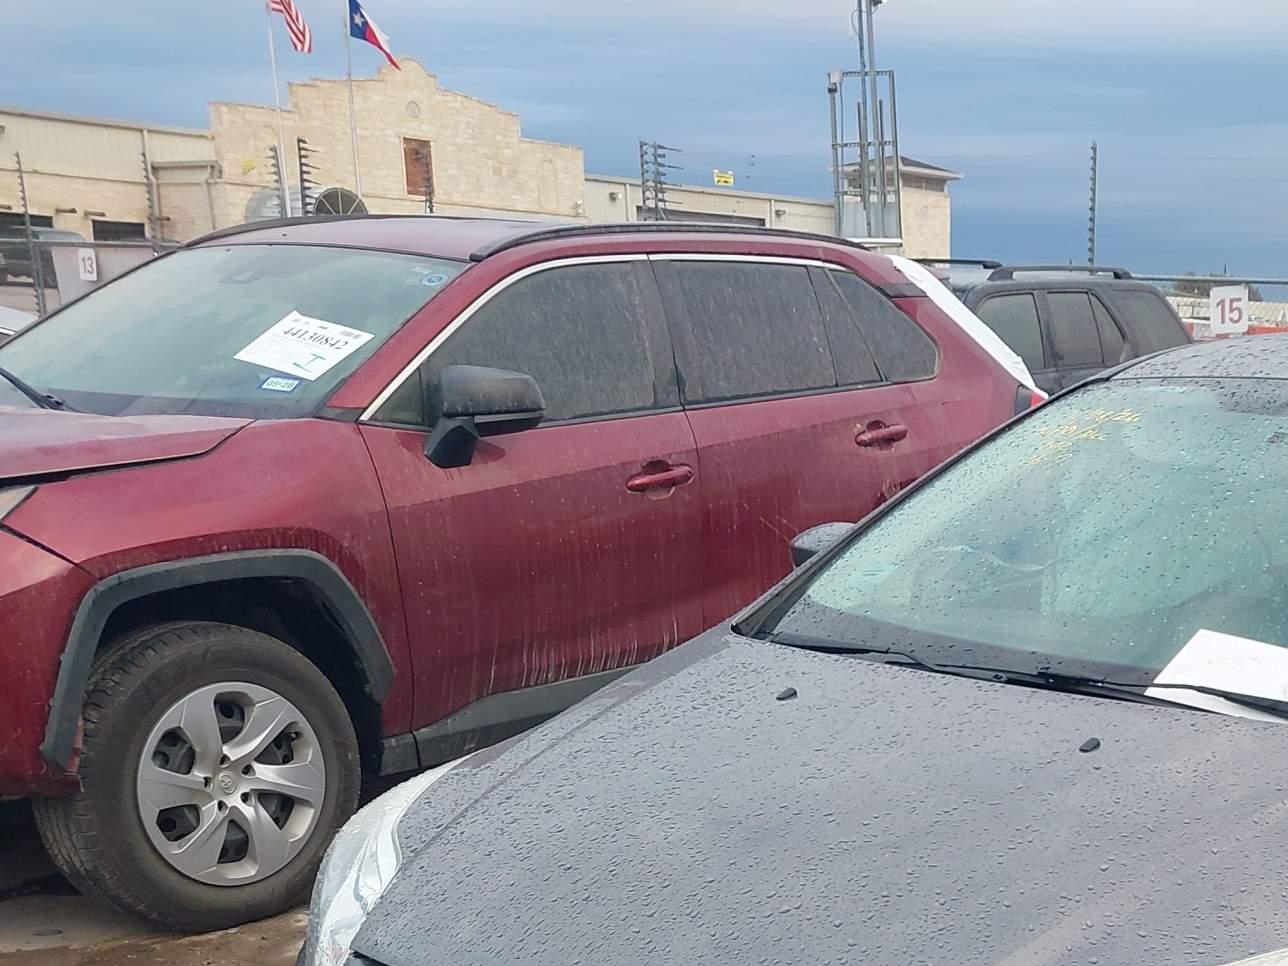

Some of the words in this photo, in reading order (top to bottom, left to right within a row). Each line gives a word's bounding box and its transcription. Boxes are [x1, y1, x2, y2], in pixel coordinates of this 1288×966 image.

[80, 256, 94, 274] 13
[1215, 297, 1243, 324] 15
[283, 326, 349, 350] 44130842
